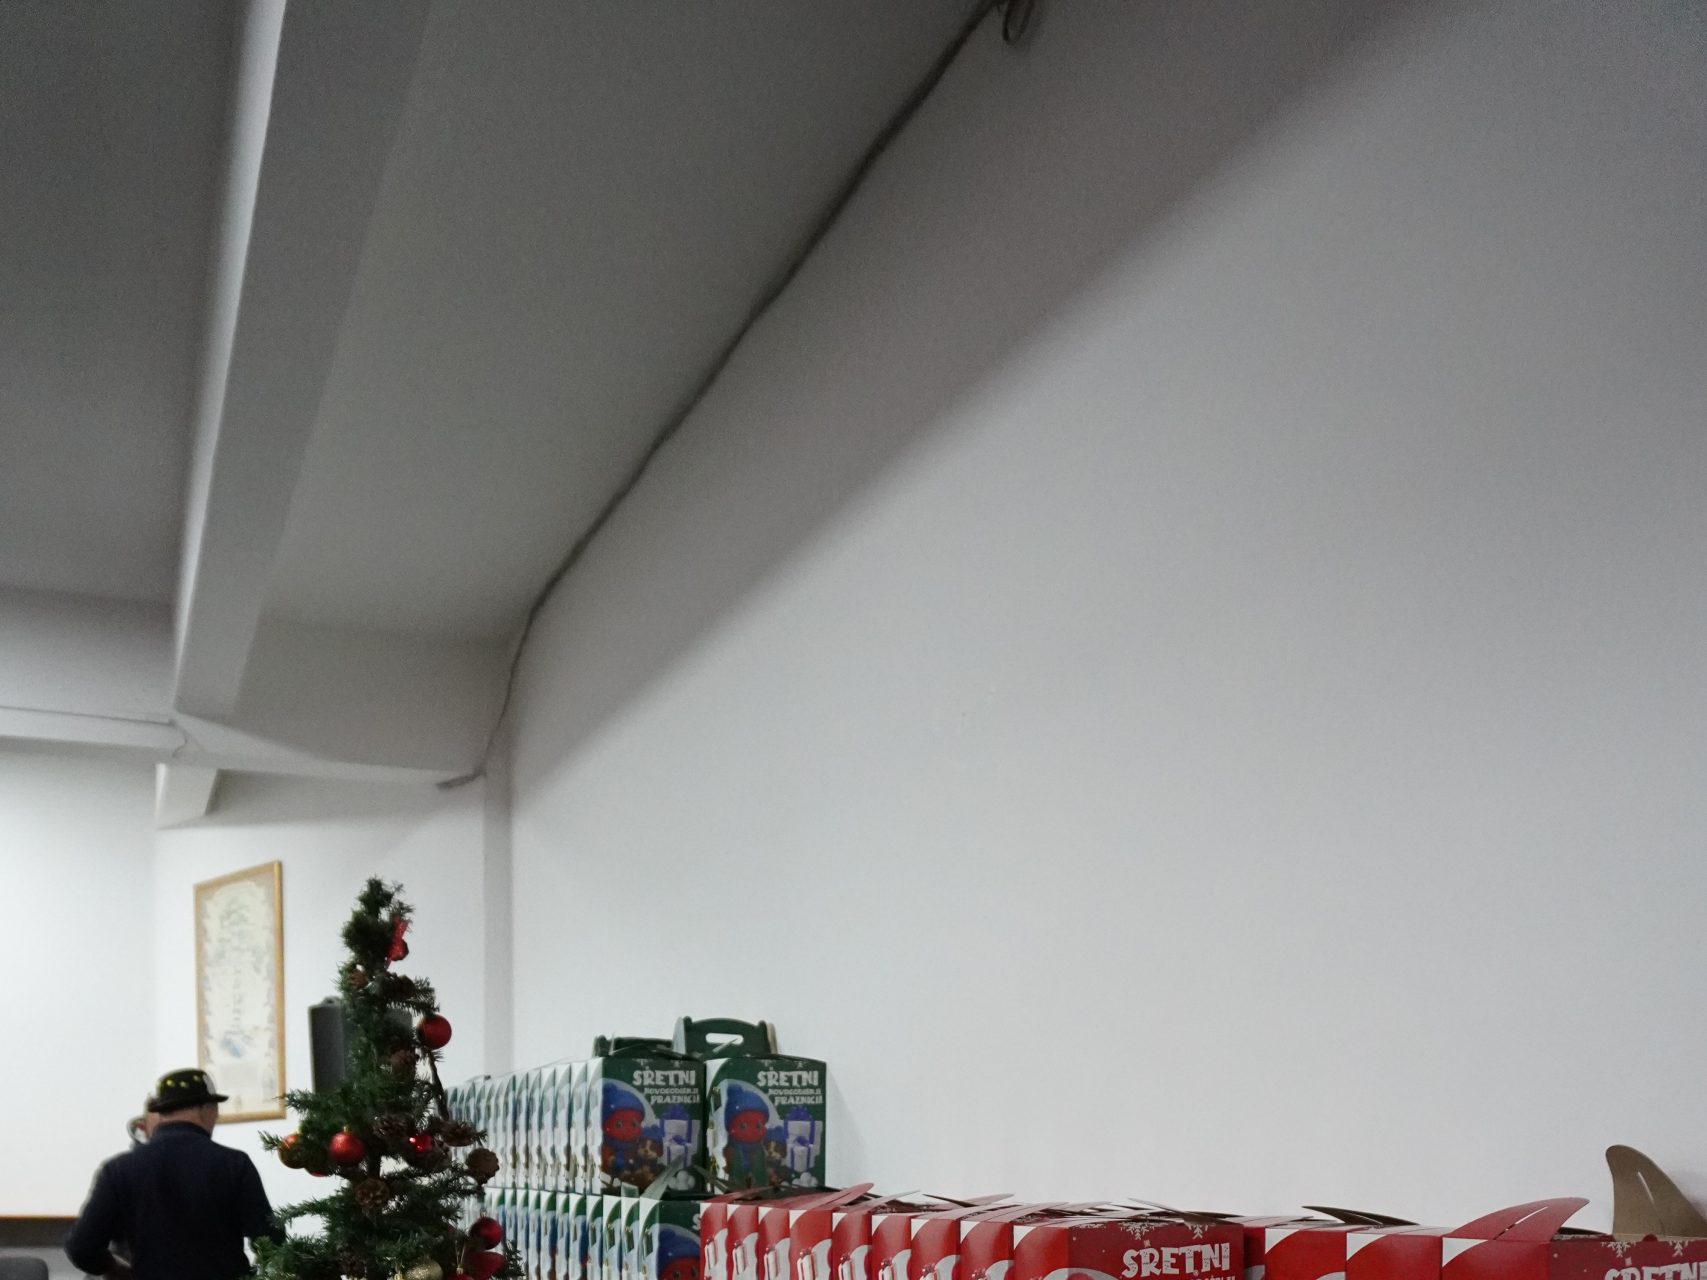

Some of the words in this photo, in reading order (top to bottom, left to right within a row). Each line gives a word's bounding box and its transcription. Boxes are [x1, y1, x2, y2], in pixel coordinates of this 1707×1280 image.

[632, 1069, 696, 1086] SRETNI
[756, 1070, 819, 1087] SRETNI
[1122, 1243, 1230, 1278] SRETNI
